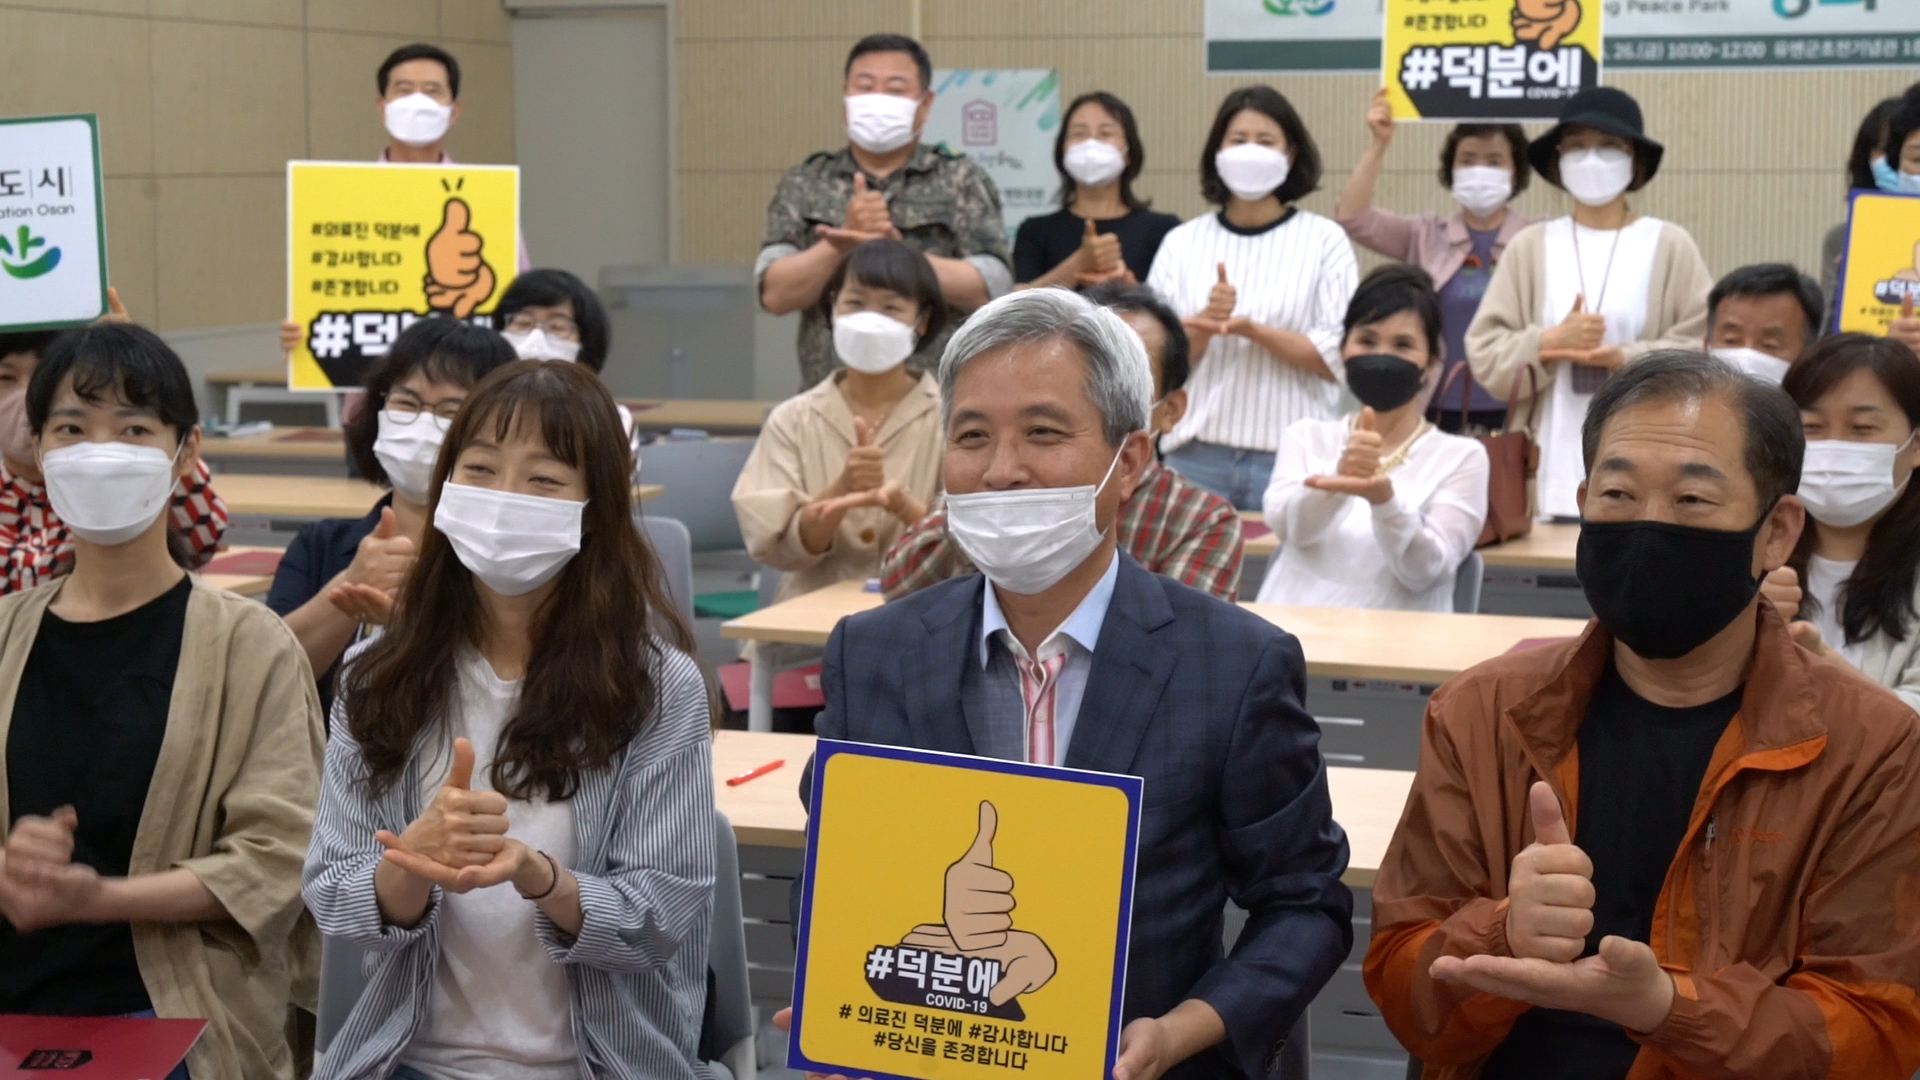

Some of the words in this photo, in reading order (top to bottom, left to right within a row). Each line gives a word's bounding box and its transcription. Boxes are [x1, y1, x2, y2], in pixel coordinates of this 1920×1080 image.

[1627, 0, 1683, 13] Peace
[1690, 0, 1729, 11] Park
[1404, 13, 1487, 31] #존경합니다
[1402, 45, 1582, 99] #덕분에
[37, 203, 75, 216] Osan
[312, 249, 402, 268] #감사합니다
[312, 279, 399, 297] #존경합니다
[866, 946, 1000, 999] #덕분에
[925, 992, 988, 1014] COVID-19
[857, 1005, 907, 1029] 의료진
[914, 1014, 963, 1038] 덕분에
[968, 1023, 1069, 1054] #감사합니다
[873, 1031, 937, 1056] #당신을
[943, 1041, 1028, 1071] 존경합니다
